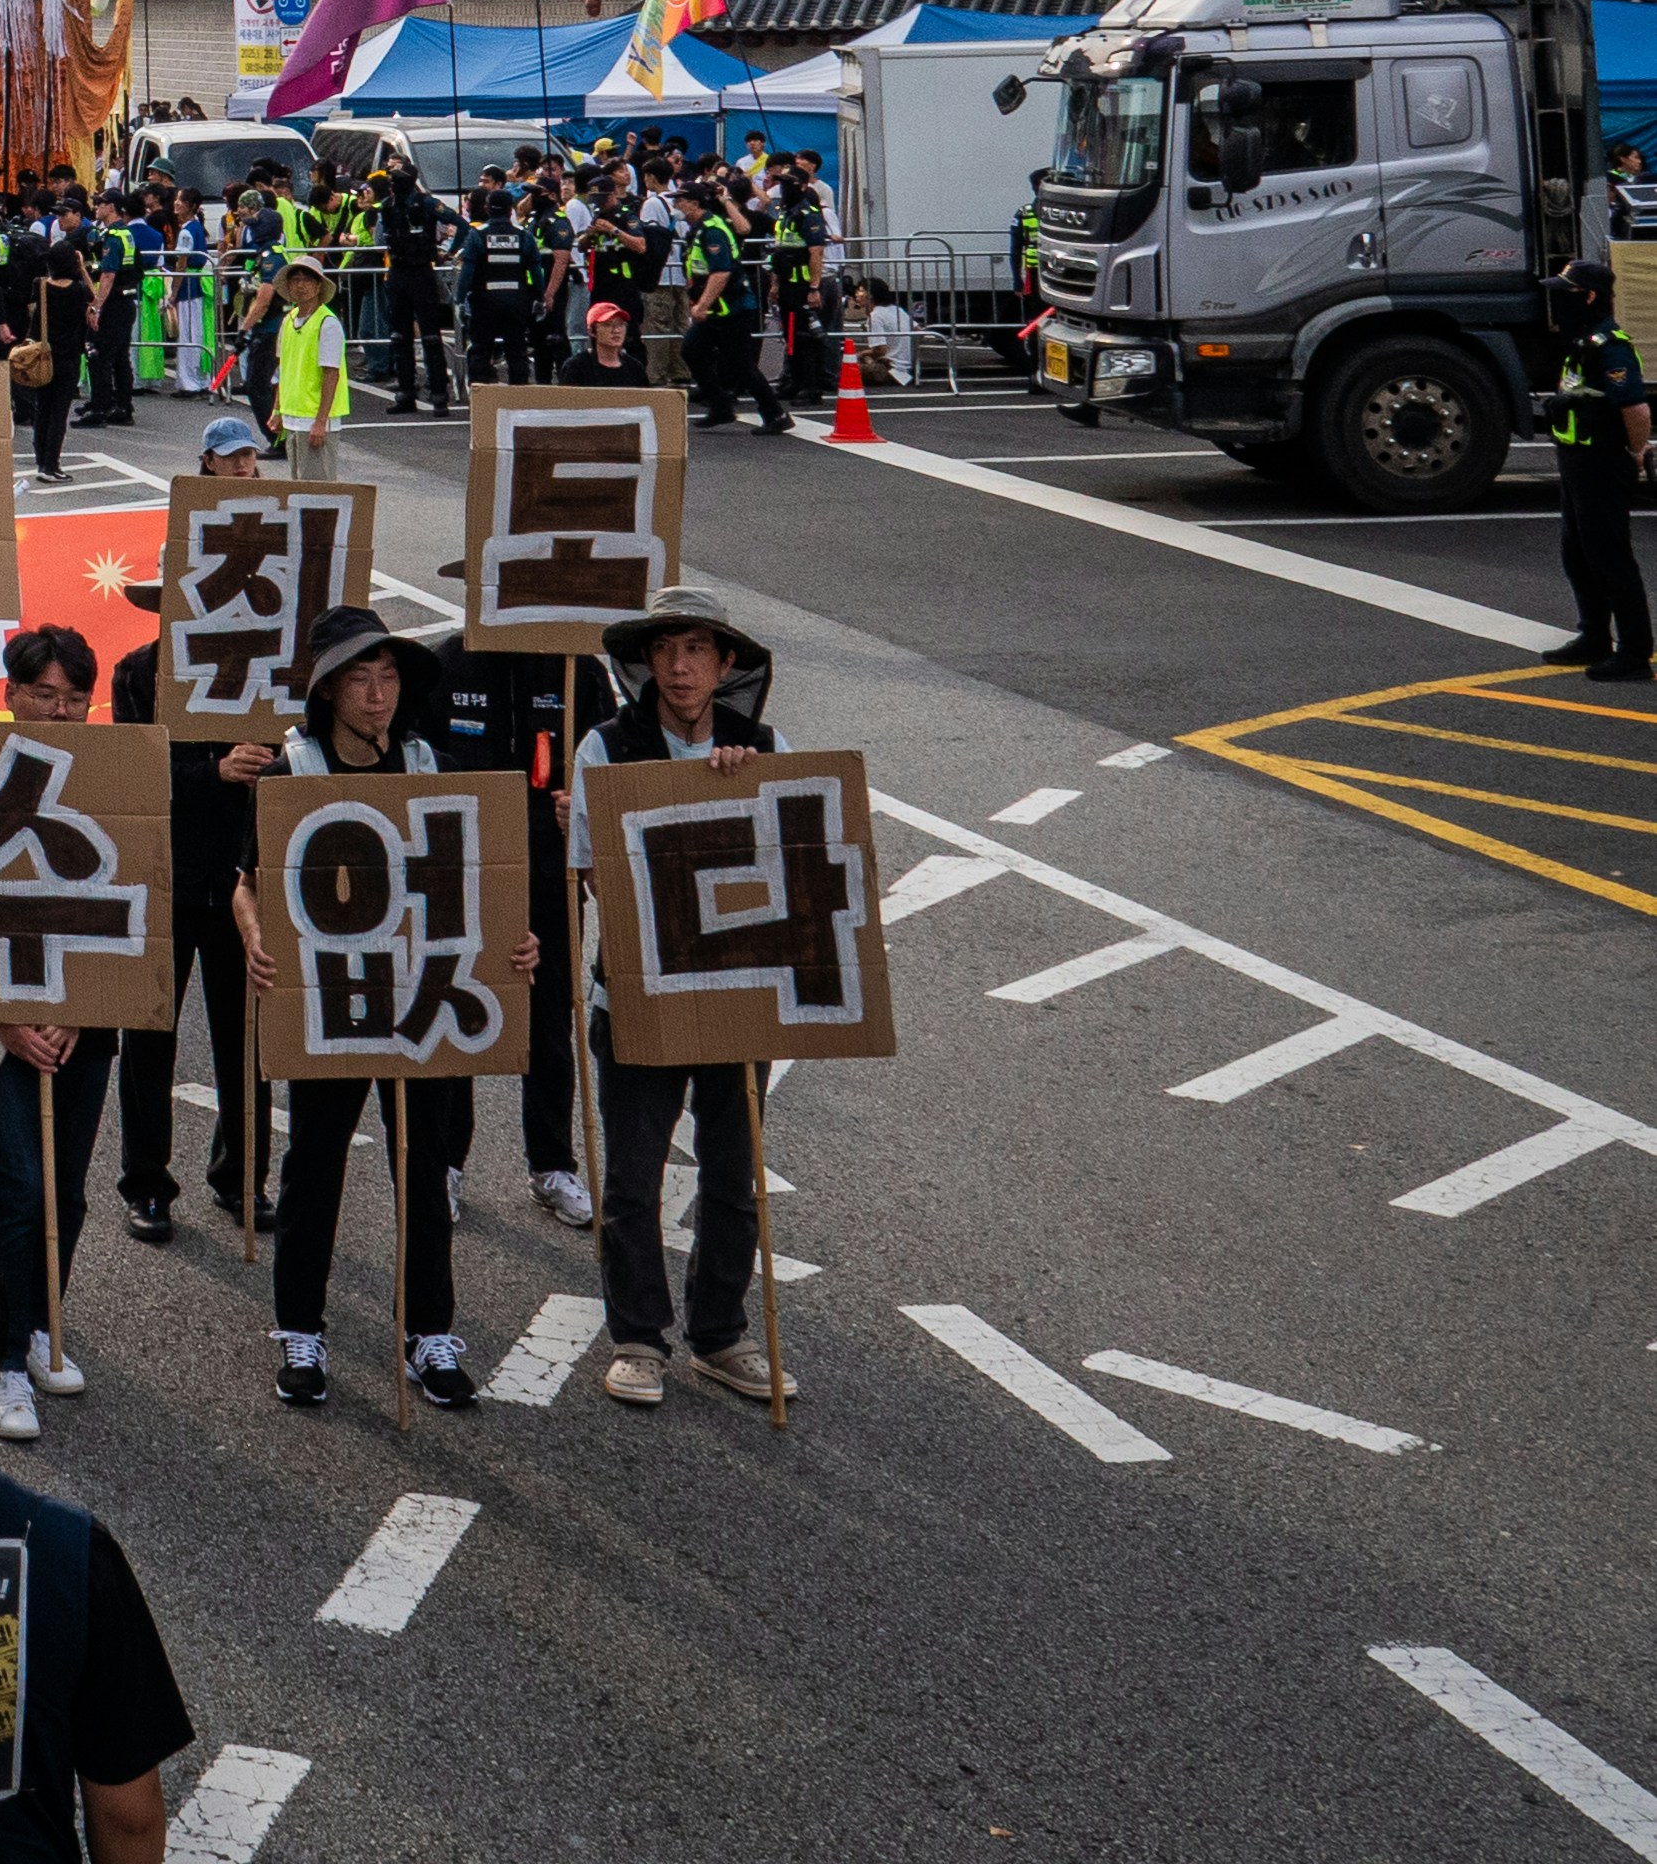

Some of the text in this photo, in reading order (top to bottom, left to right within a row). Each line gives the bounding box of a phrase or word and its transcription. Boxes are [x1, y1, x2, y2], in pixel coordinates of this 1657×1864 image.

[171, 494, 354, 713] 춰
[481, 407, 665, 623] 도
[285, 794, 502, 1063] 없
[622, 776, 864, 1024] 다
